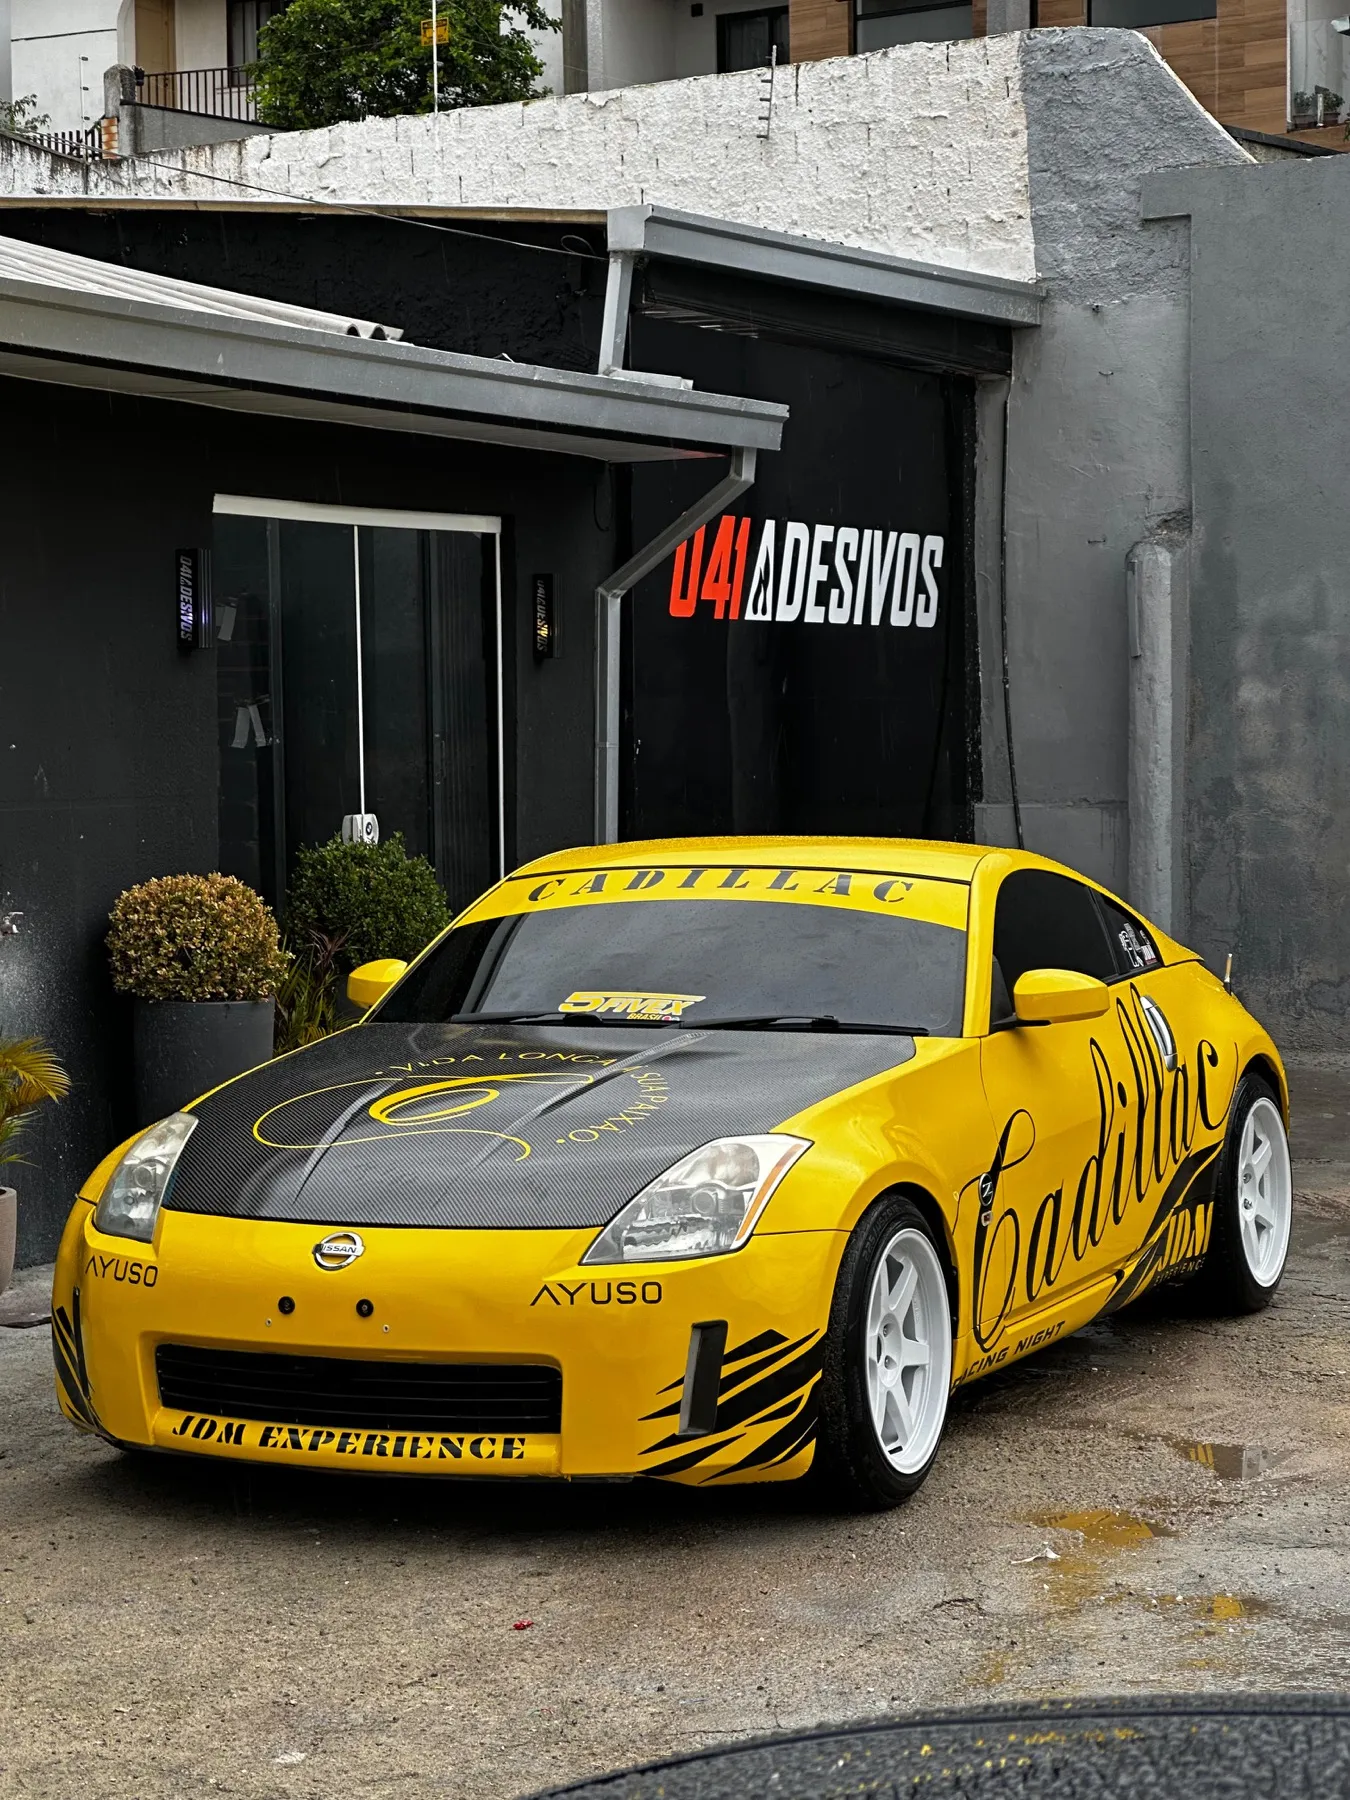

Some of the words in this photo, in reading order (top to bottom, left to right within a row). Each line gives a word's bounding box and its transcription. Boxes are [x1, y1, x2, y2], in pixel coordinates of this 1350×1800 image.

[528, 869, 914, 903] CADILLAC
[953, 982, 1238, 1353] Cadillac
[85, 1255, 158, 1288] AYUSO
[530, 1281, 663, 1306] AYUSO
[1013, 1320, 1066, 1356] NIGHT
[172, 1415, 247, 1446] JDM
[258, 1425, 526, 1460] EXPERIENCE
